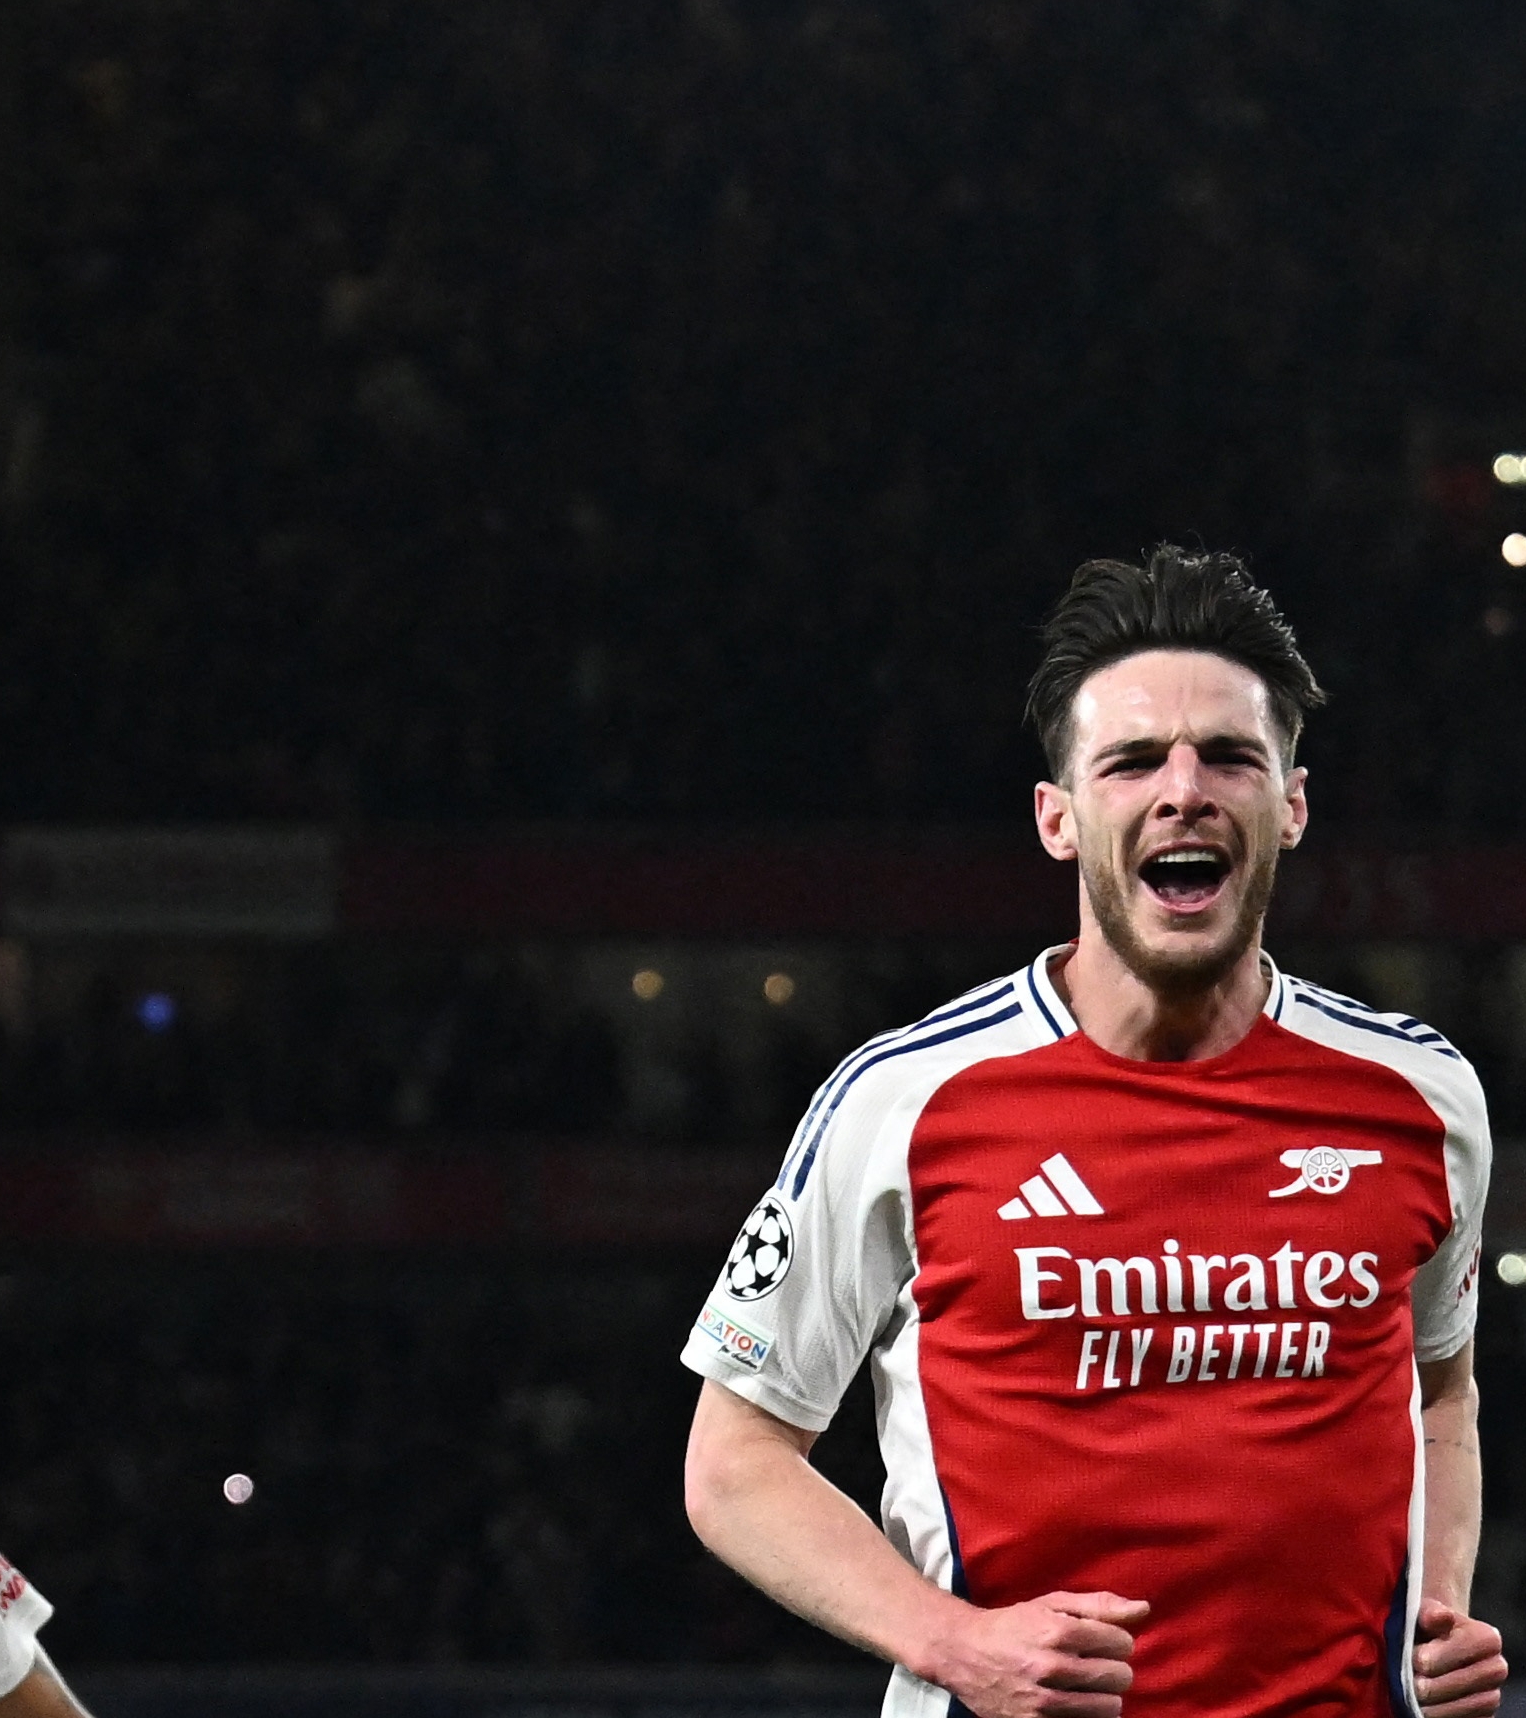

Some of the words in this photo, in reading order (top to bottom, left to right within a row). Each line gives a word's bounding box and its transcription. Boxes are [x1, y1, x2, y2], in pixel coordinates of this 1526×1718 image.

[1013, 1238, 1380, 1320] Emirates
[1075, 1328, 1153, 1389] FLY
[1166, 1321, 1331, 1383] BETTER
